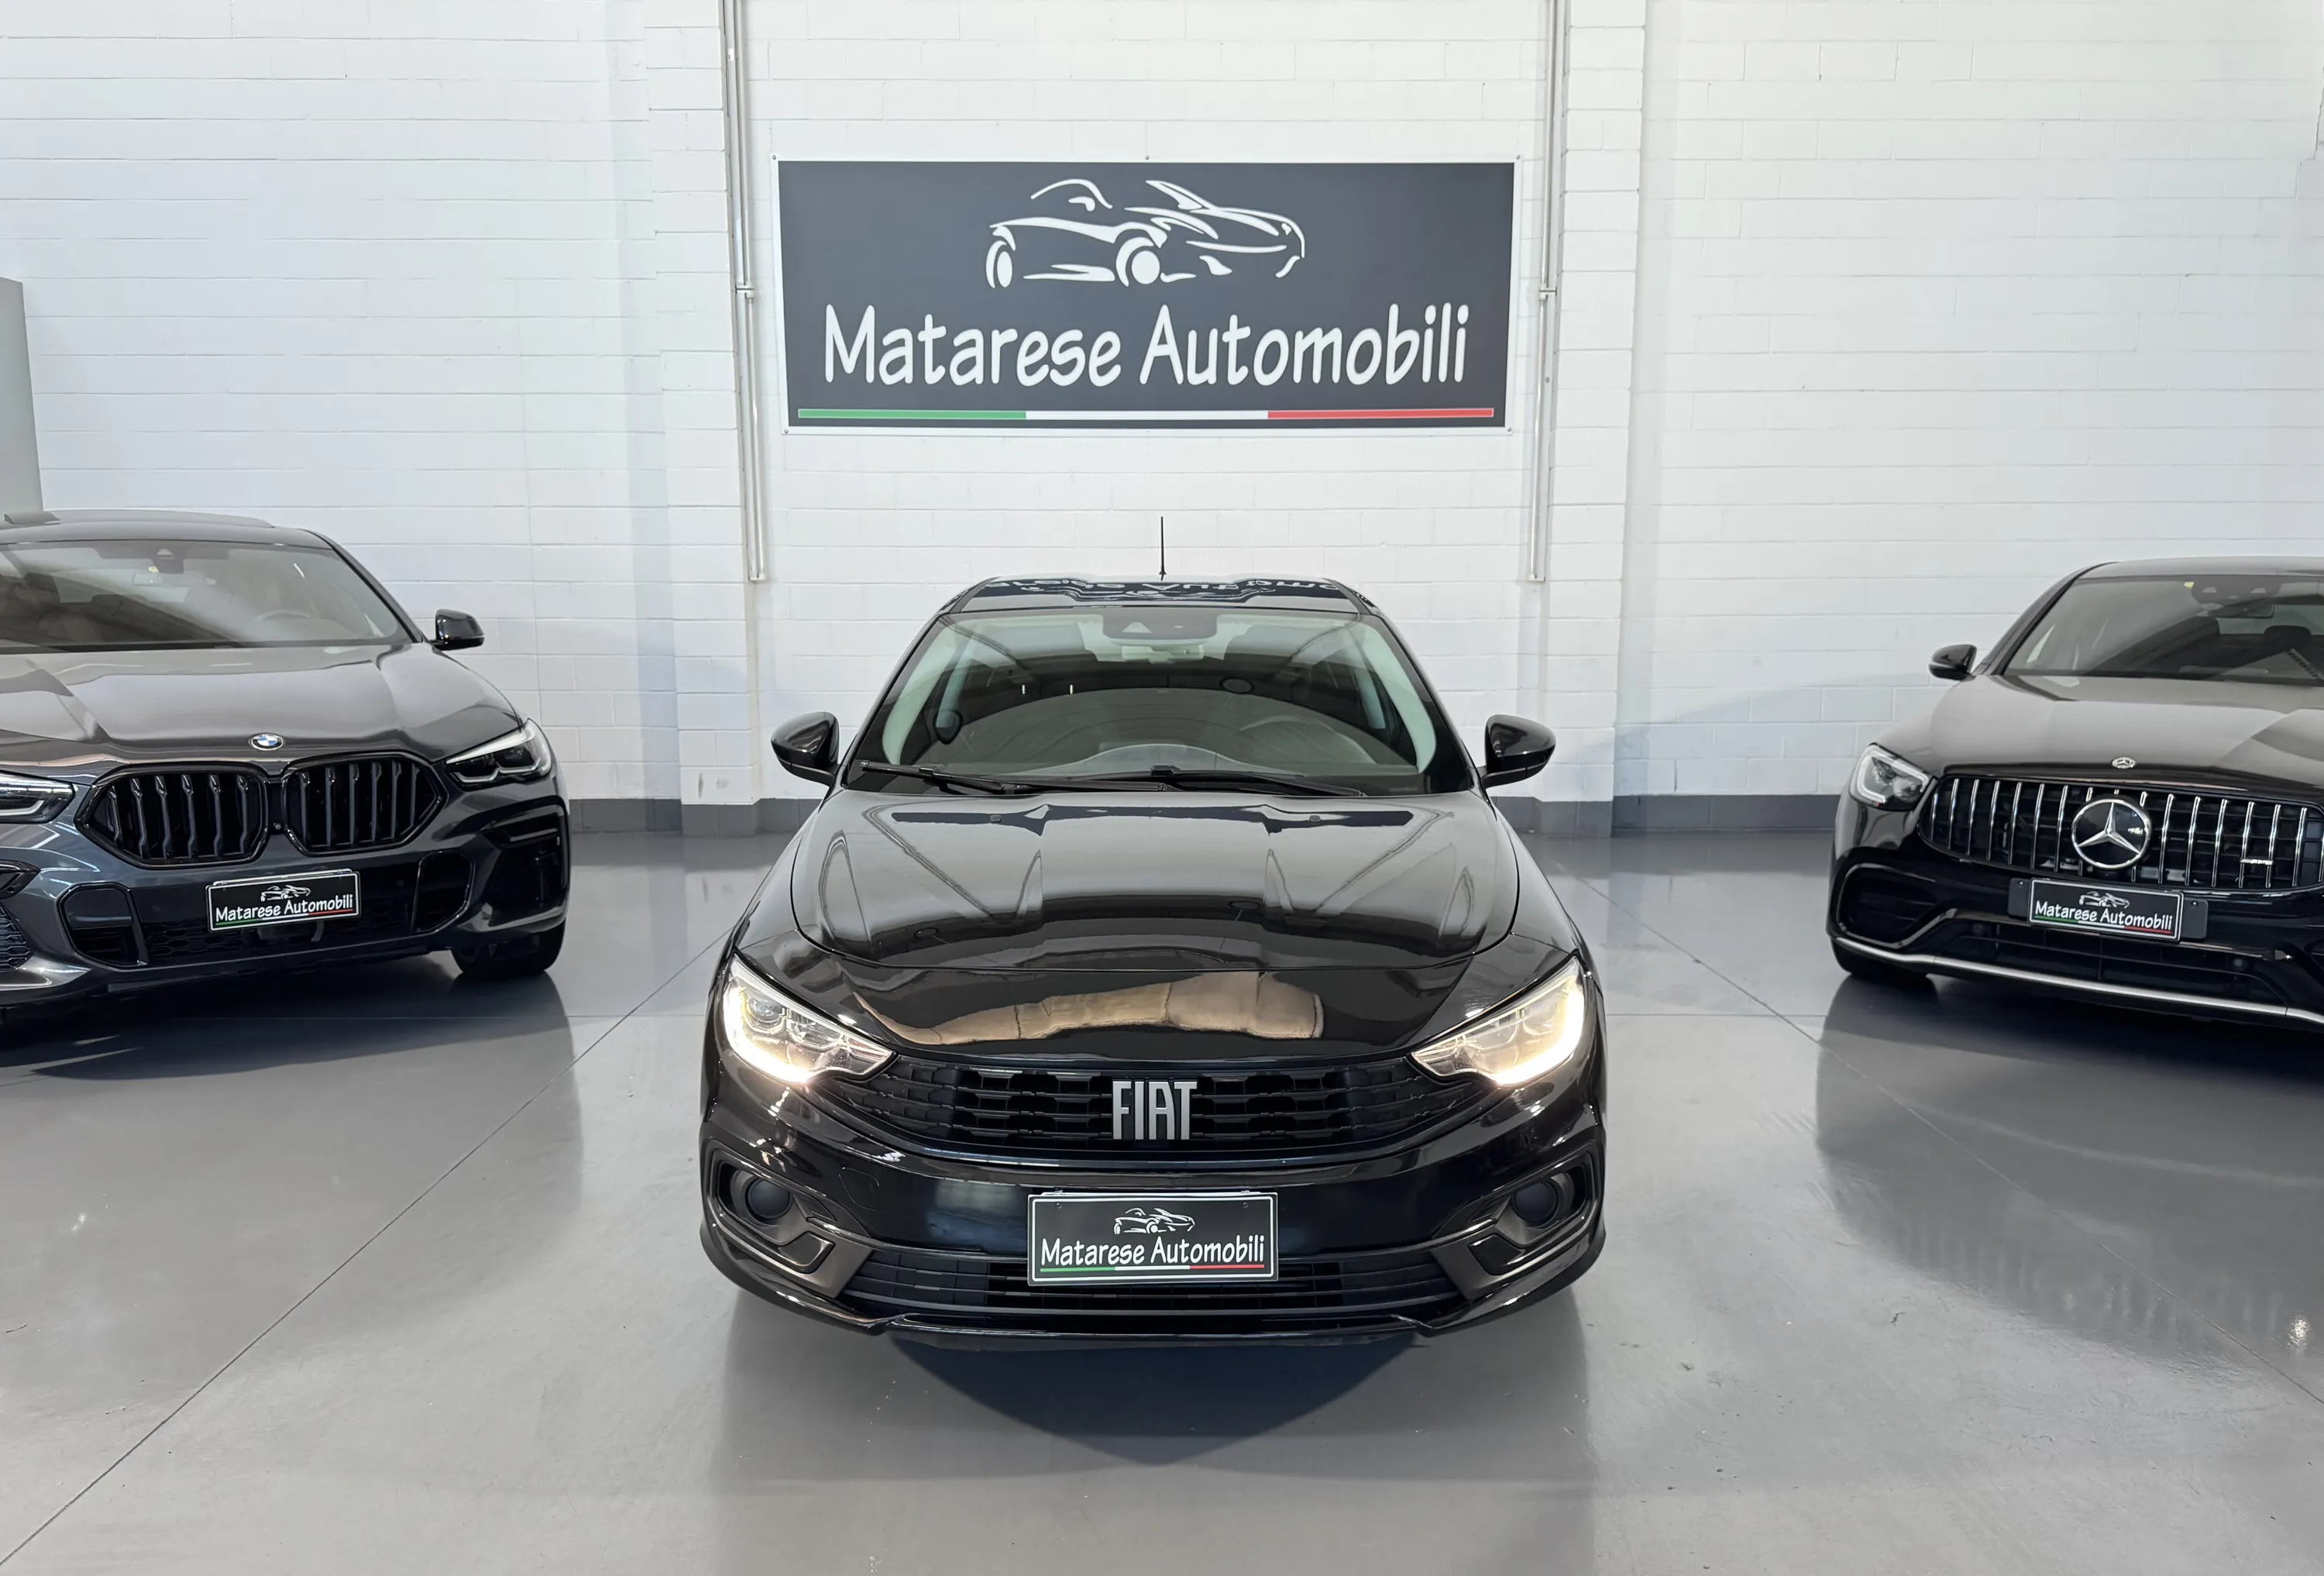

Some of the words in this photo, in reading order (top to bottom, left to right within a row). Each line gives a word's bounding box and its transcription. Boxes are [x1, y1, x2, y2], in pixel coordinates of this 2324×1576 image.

[825, 304, 1122, 387] Matarese
[1139, 301, 1469, 387] Automobili
[215, 905, 281, 922] Matarese
[284, 894, 353, 914] Automobili
[2034, 900, 2098, 922] Matarese
[2099, 907, 2173, 930] Automobili
[1112, 1080, 1198, 1141] FIAT
[1040, 1237, 1145, 1266] Matarese
[1150, 1234, 1264, 1265] Automobili
